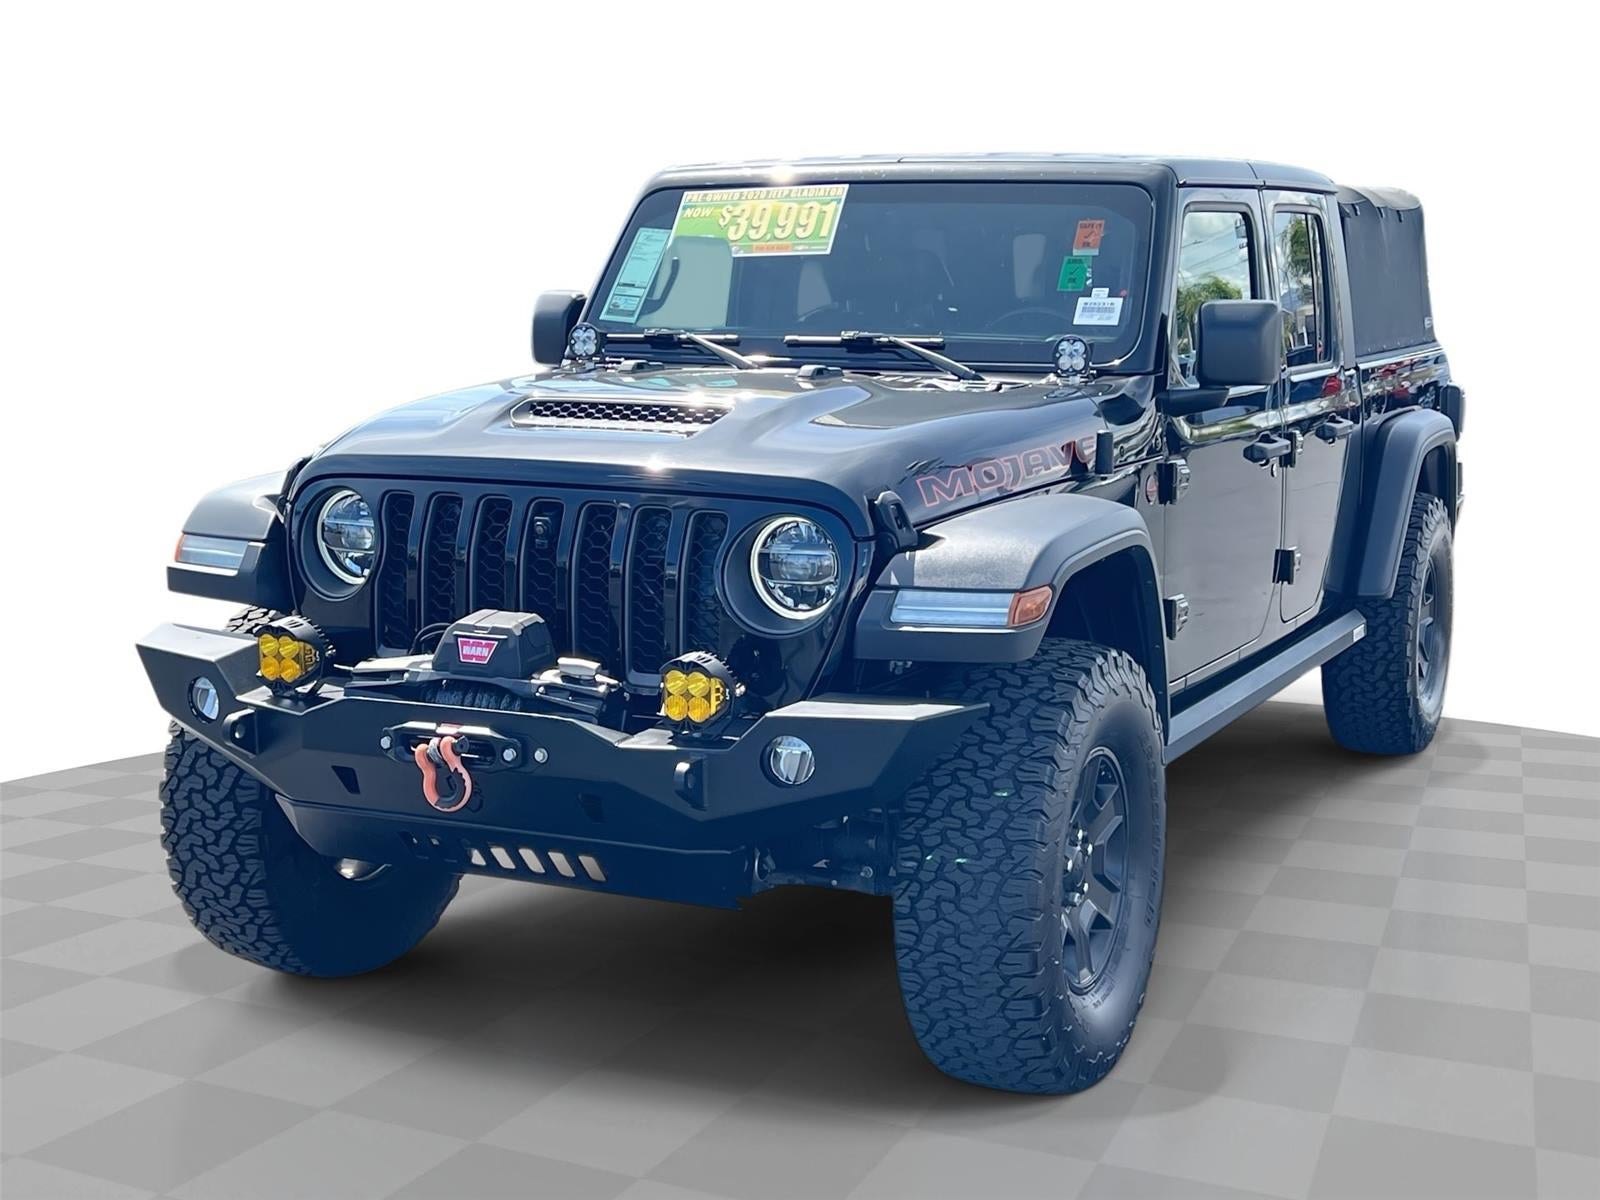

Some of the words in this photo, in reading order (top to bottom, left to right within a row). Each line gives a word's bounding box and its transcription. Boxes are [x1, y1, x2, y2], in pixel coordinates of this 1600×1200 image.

[791, 186, 844, 198] GLADIATOR
[683, 207, 714, 218] NOW
[718, 200, 838, 242] $39,991
[916, 436, 1095, 508] MOJAVE
[462, 645, 490, 657] WARN
